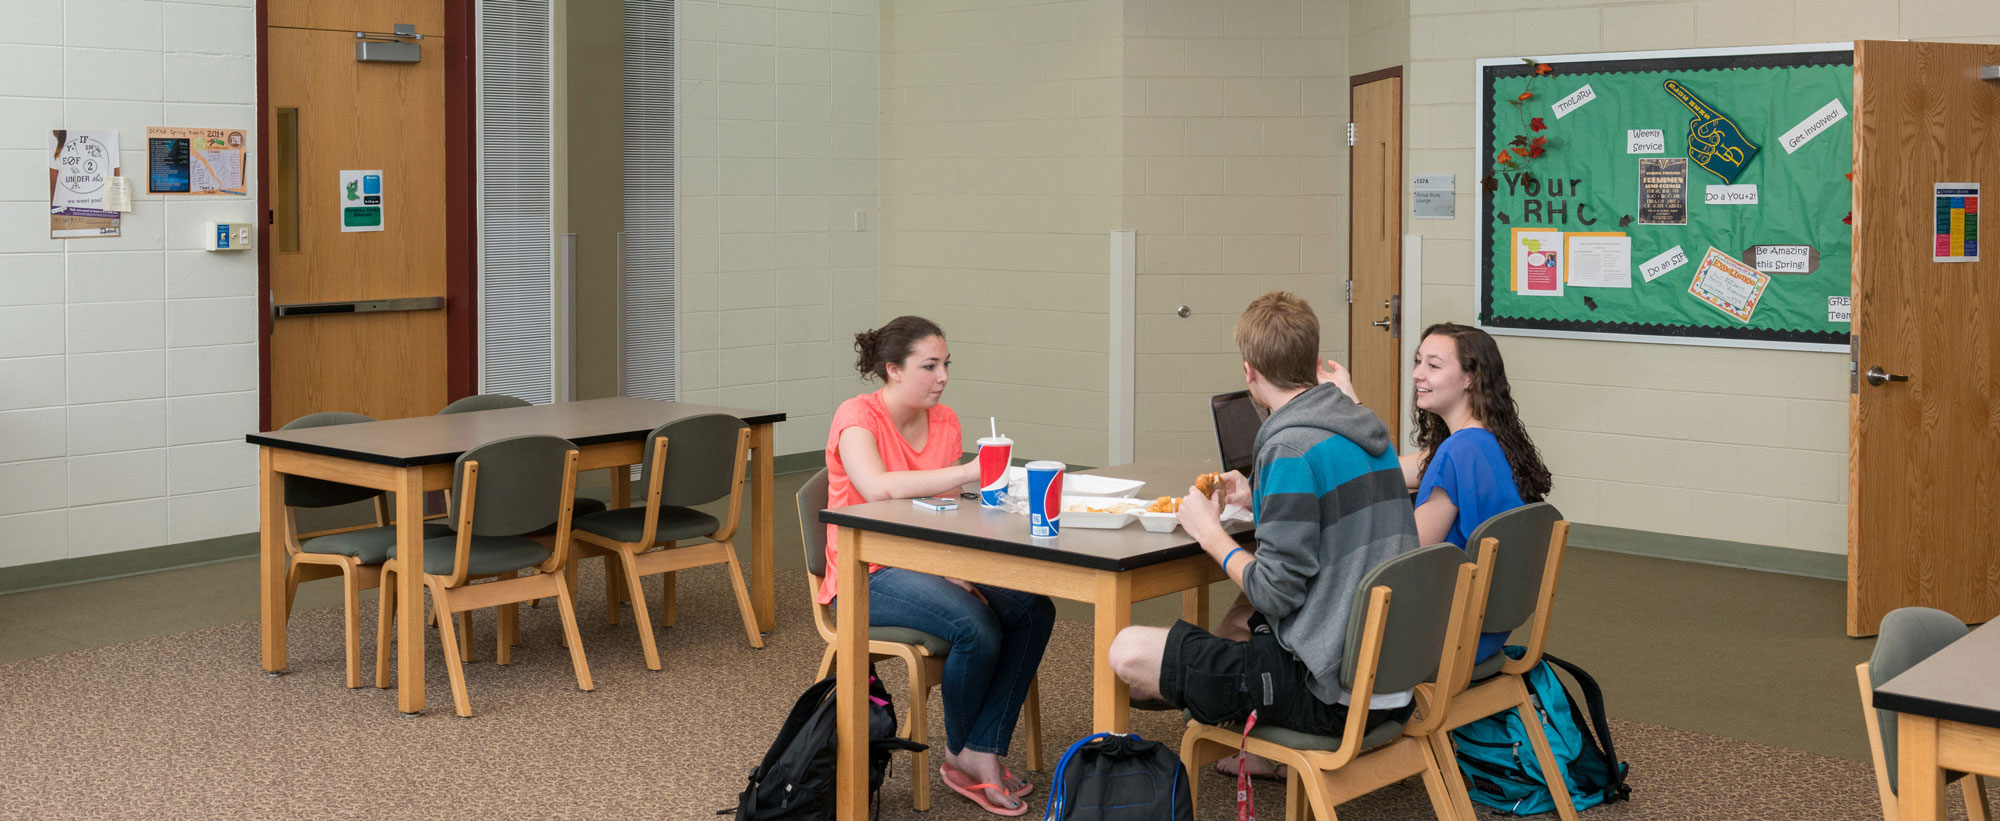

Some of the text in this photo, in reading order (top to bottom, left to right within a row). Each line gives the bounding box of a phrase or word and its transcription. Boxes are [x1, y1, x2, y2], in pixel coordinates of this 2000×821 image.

[1788, 109, 1840, 148] Get involved!
[207, 130, 225, 138] 2014
[80, 135, 89, 144] IF
[1632, 143, 1663, 152] Service
[87, 161, 93, 171] 2
[1503, 172, 1582, 197] Your
[1705, 192, 1719, 201] Do
[1720, 193, 1726, 201] a
[1756, 246, 1808, 256] Be Amazing
[1647, 266, 1660, 277] Do
[1660, 260, 1671, 270] an
[1756, 260, 1805, 270] this Spring!
[1828, 296, 1851, 306] GRE
